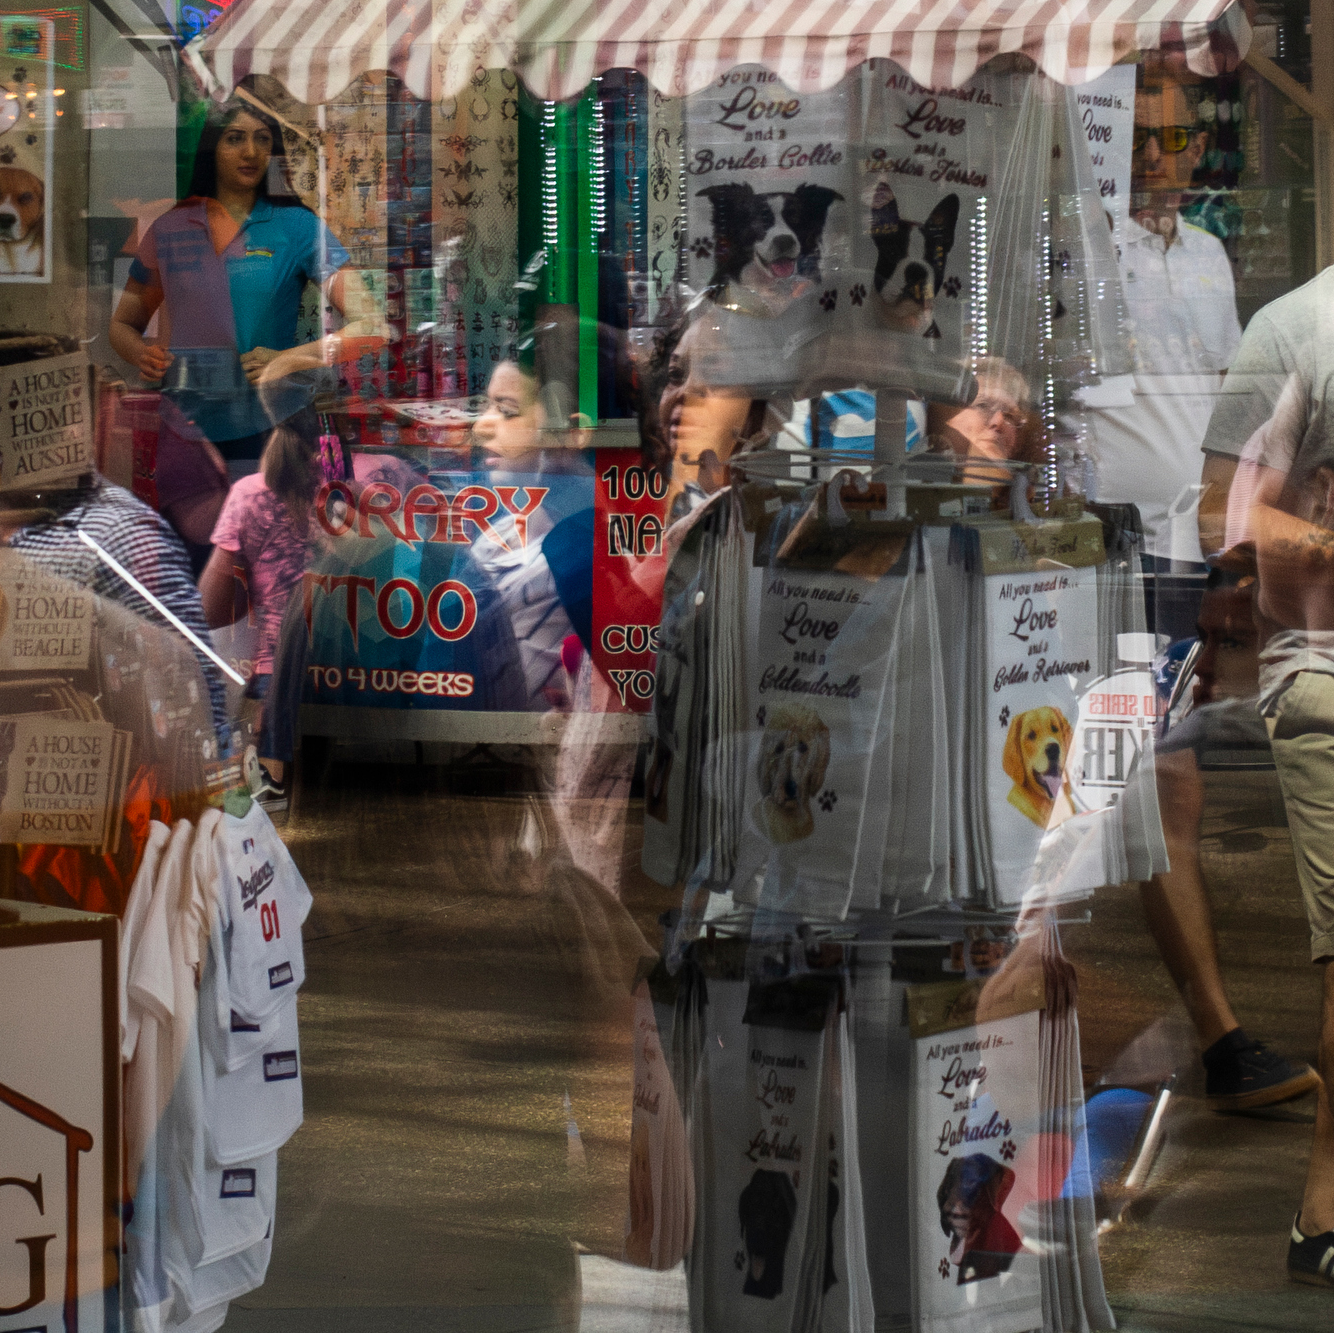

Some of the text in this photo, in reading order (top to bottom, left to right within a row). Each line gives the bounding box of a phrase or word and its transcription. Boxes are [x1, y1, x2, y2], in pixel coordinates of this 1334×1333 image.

[720, 70, 753, 89] you
[886, 73, 906, 93] All
[716, 87, 802, 131] Love
[1077, 92, 1113, 108] you need
[894, 99, 966, 138] Love
[745, 125, 774, 142] and
[687, 148, 844, 176] Border Collie
[914, 143, 935, 157] and
[9, 366, 83, 398] A HOUSE
[33, 391, 59, 408] NOT
[9, 401, 84, 439] HOME
[11, 428, 63, 454] WITHOUT
[14, 443, 87, 477] AUSSIE
[601, 465, 670, 501] 100
[767, 579, 844, 605] All you need
[998, 577, 1056, 603] All you need
[13, 596, 86, 621] HOME
[1009, 597, 1059, 642] Love
[13, 622, 69, 637] WITHOUT
[778, 601, 840, 644] Love
[13, 637, 83, 658] BEAGLE
[793, 649, 815, 665] and
[1027, 642, 1041, 657] and
[308, 665, 475, 697] TO 4 WEEKS
[992, 657, 1092, 693] Golden Retriever
[26, 735, 103, 755] A HOUSE
[23, 771, 98, 796] HOME
[22, 796, 79, 812] WITHOUT
[20, 813, 94, 833] BOSTON
[258, 899, 281, 943] 01
[750, 1049, 766, 1066] All
[780, 1054, 798, 1068] need
[926, 1037, 990, 1061] All you need
[756, 1069, 796, 1109] Love
[937, 1057, 988, 1100] Love
[952, 1098, 970, 1113] and
[933, 1110, 1013, 1157] Labrador
